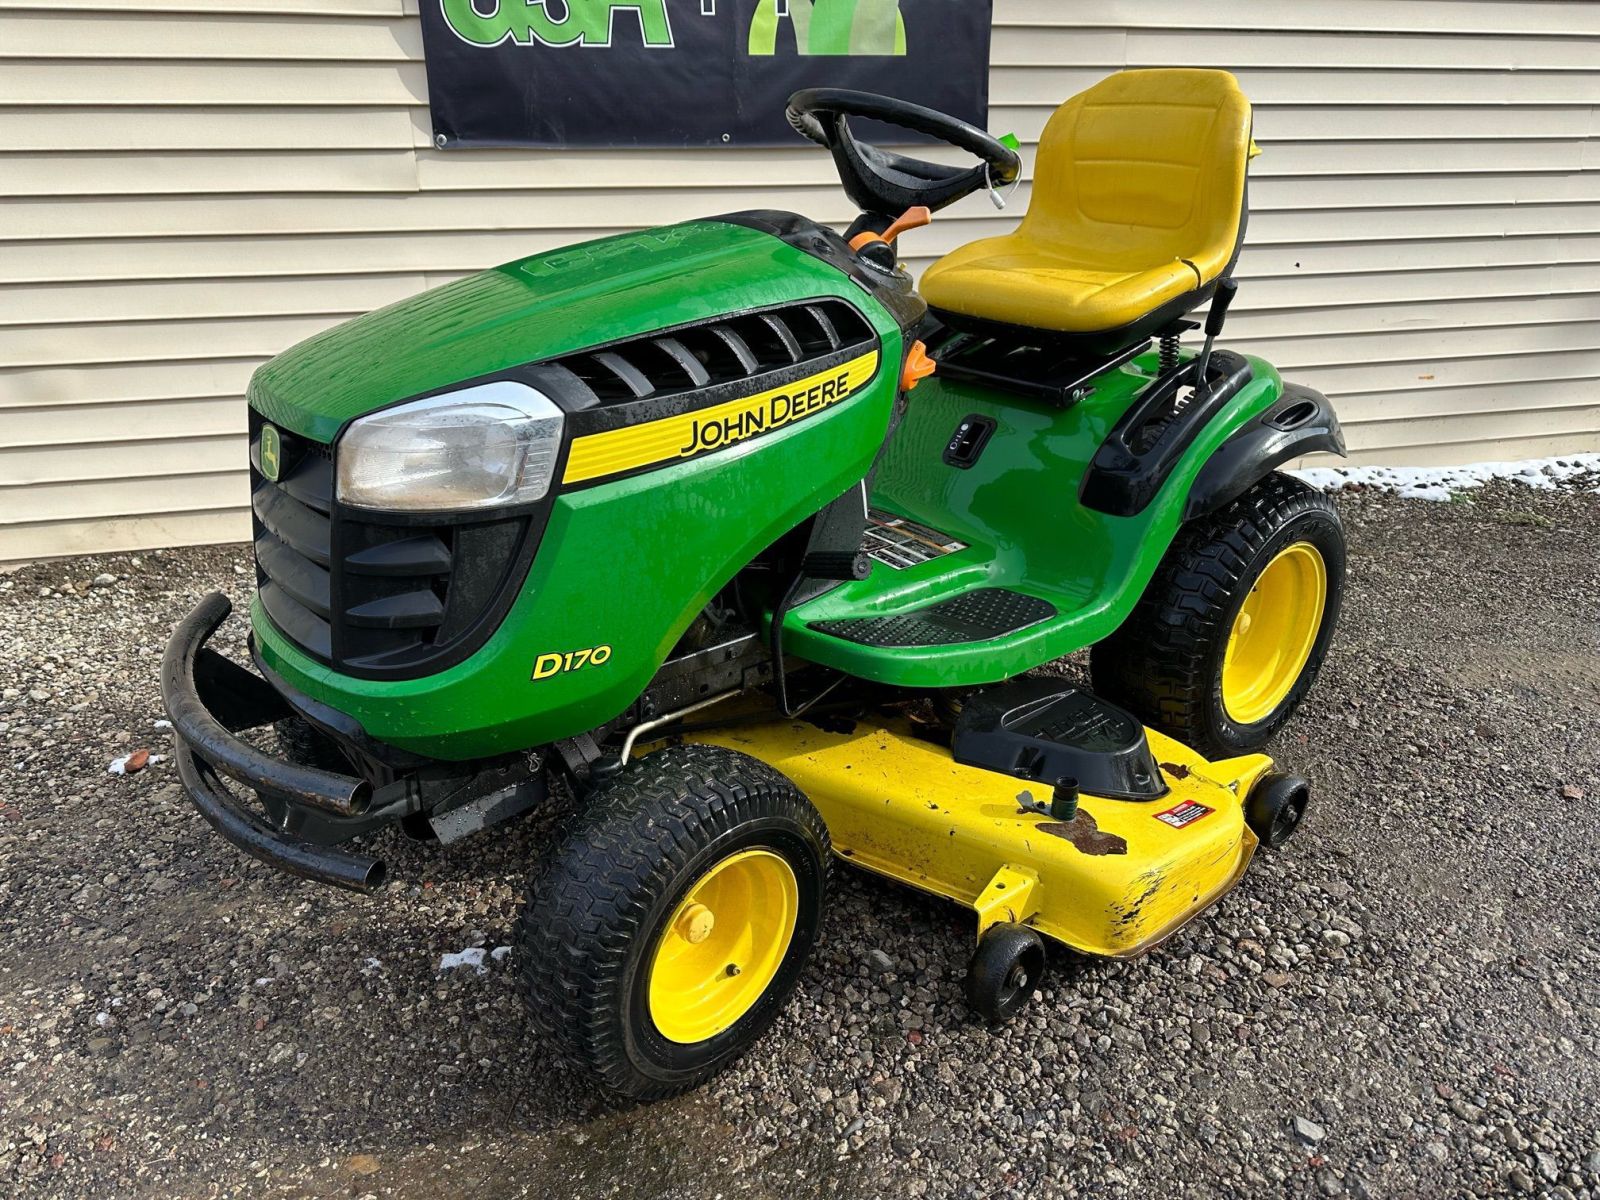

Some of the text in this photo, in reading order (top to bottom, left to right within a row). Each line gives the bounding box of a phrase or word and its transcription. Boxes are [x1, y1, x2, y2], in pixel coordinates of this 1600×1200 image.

[680, 372, 850, 454] JOHN DEERE
[531, 645, 612, 681] D170
